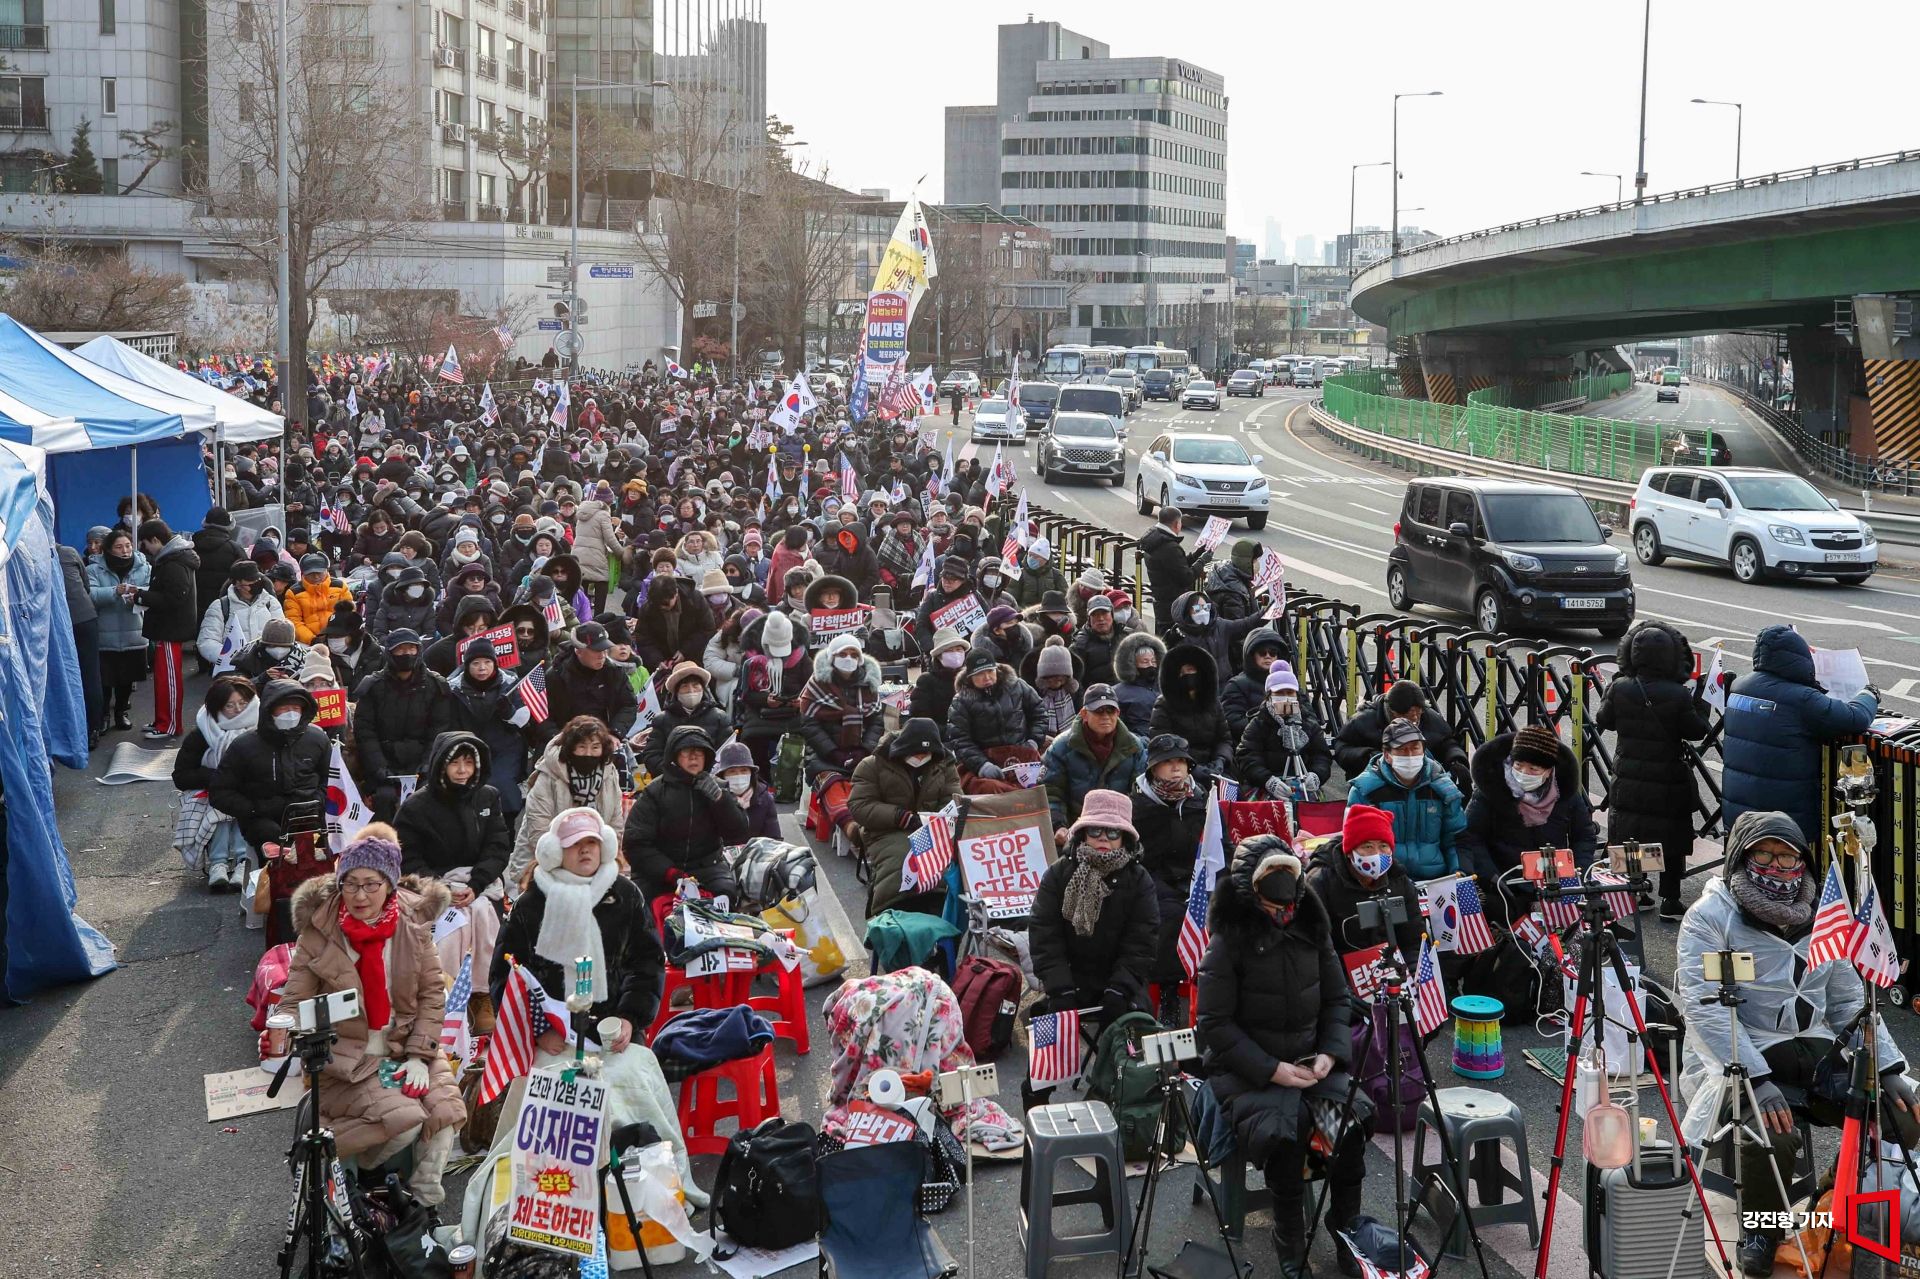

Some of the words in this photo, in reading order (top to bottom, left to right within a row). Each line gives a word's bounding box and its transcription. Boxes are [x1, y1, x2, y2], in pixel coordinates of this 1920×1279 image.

[1178, 64, 1203, 82] VOLVO
[870, 322, 905, 337] 이재명
[1210, 520, 1228, 529] STOP
[932, 594, 980, 629] 탄핵반대
[1586, 599, 1604, 608] 5752
[812, 611, 864, 631] 탄핵반대
[486, 627, 512, 641] 민주당
[971, 834, 1030, 861] STOP
[981, 854, 1028, 879] THE
[554, 1079, 577, 1106] 12범
[580, 1087, 605, 1112] 수괴
[517, 1103, 600, 1167] 이재명
[539, 1173, 570, 1192] 당장
[513, 1194, 594, 1240] 체포하라!
